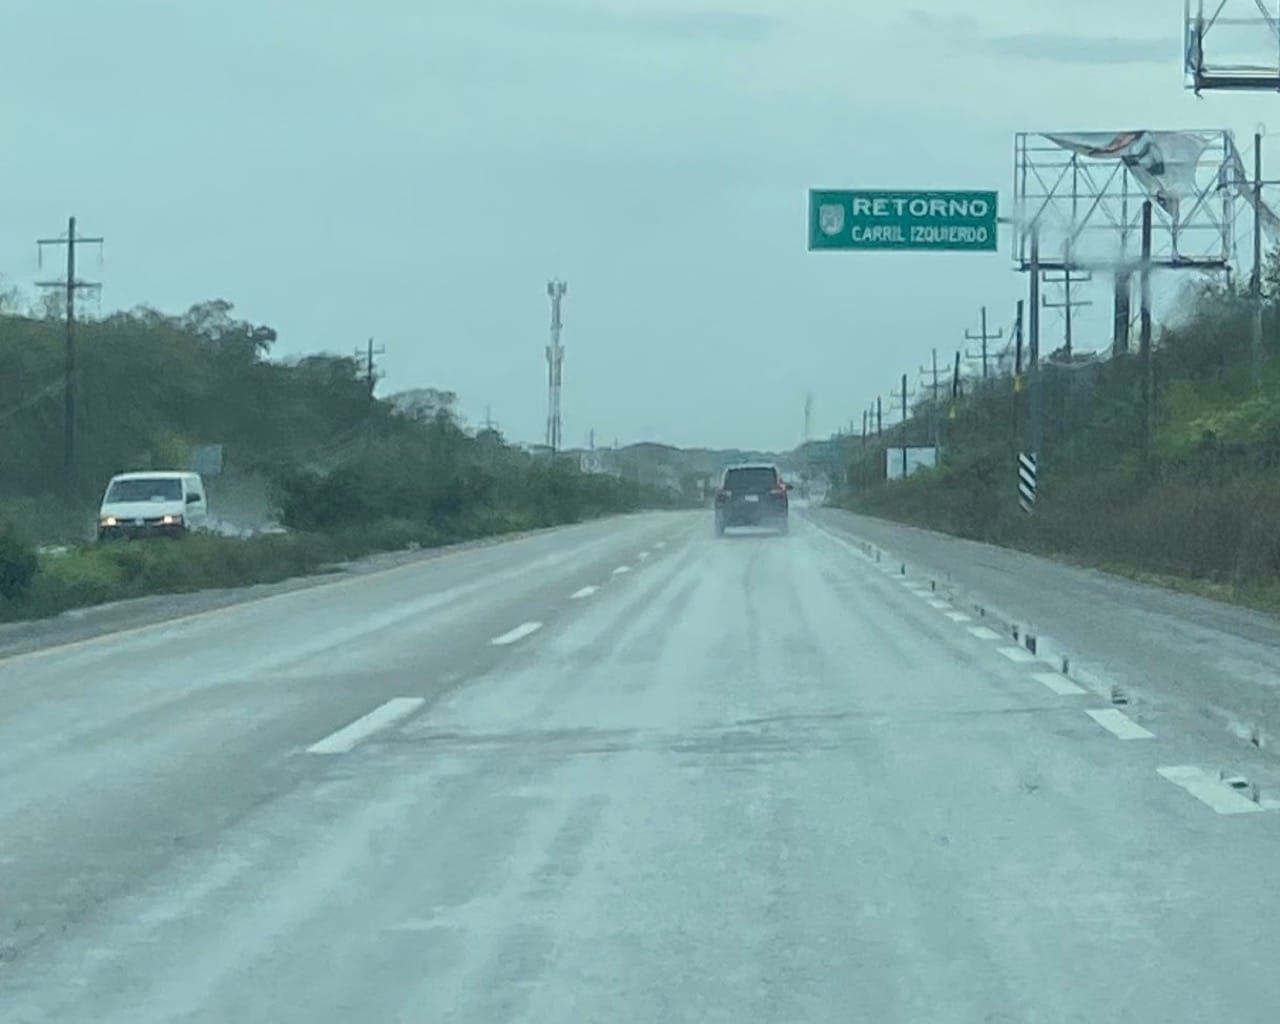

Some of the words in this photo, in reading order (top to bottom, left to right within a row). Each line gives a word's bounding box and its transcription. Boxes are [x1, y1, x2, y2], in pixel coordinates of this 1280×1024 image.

[853, 198, 988, 217] RETORNO
[852, 226, 905, 242] CARRIL
[910, 226, 988, 243] IZQUIERDO
